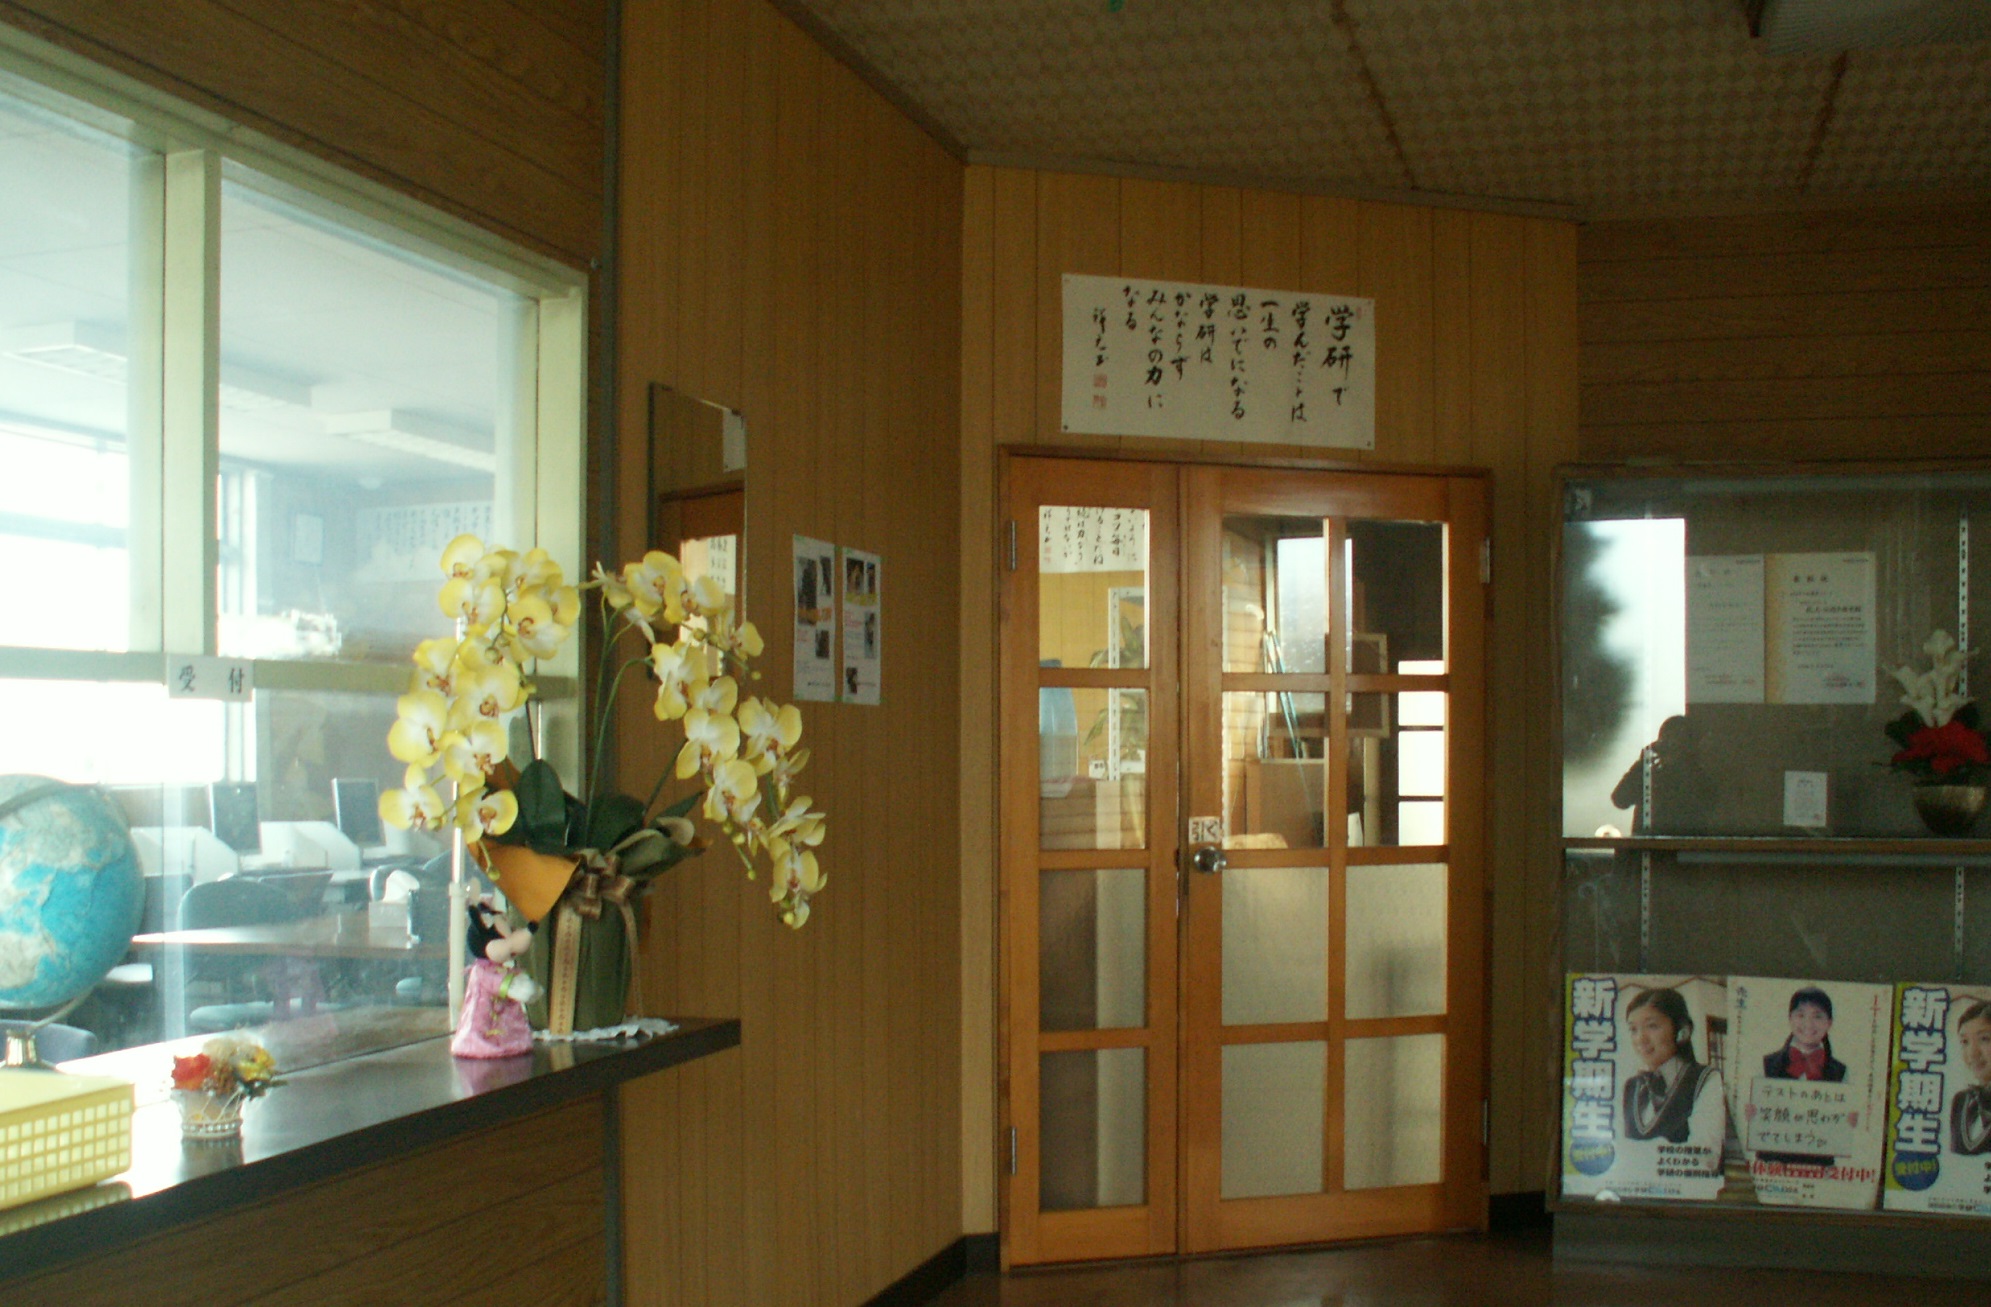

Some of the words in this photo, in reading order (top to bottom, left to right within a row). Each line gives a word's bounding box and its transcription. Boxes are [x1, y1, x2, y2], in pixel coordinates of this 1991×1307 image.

[1122, 285, 1140, 331] なる
[1195, 292, 1219, 364] 学研は
[1259, 300, 1280, 350] 一生の
[1144, 289, 1167, 409] みんなの力に
[1320, 304, 1354, 406] 学研で
[179, 664, 245, 694] 受付
[1192, 820, 1218, 841] 引く
[1571, 977, 1617, 1140] 新学期生
[1895, 986, 1950, 1154] 新学期生
